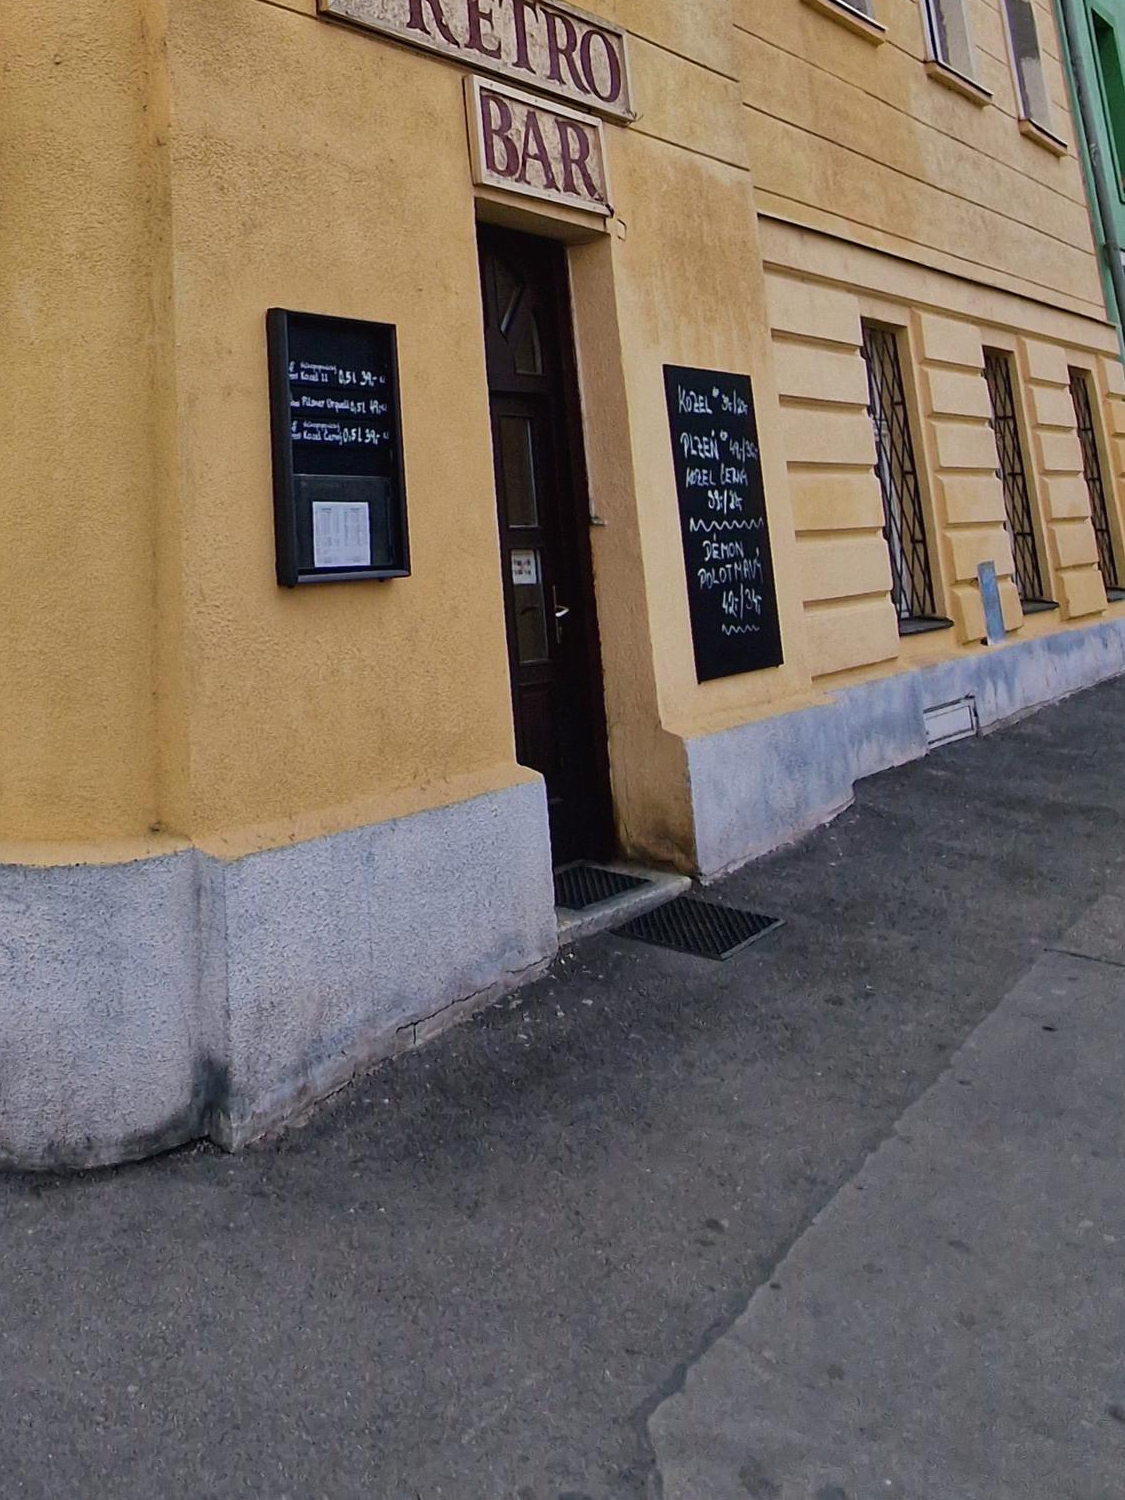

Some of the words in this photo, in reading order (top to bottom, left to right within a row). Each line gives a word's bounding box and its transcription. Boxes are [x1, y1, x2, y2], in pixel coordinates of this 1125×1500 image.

[481, 94, 604, 201] BAR
[678, 384, 713, 414] KOZEL
[686, 467, 716, 488] KOZEL
[702, 533, 744, 561] DÉMON
[697, 547, 763, 590] POLOTMAVÝ
